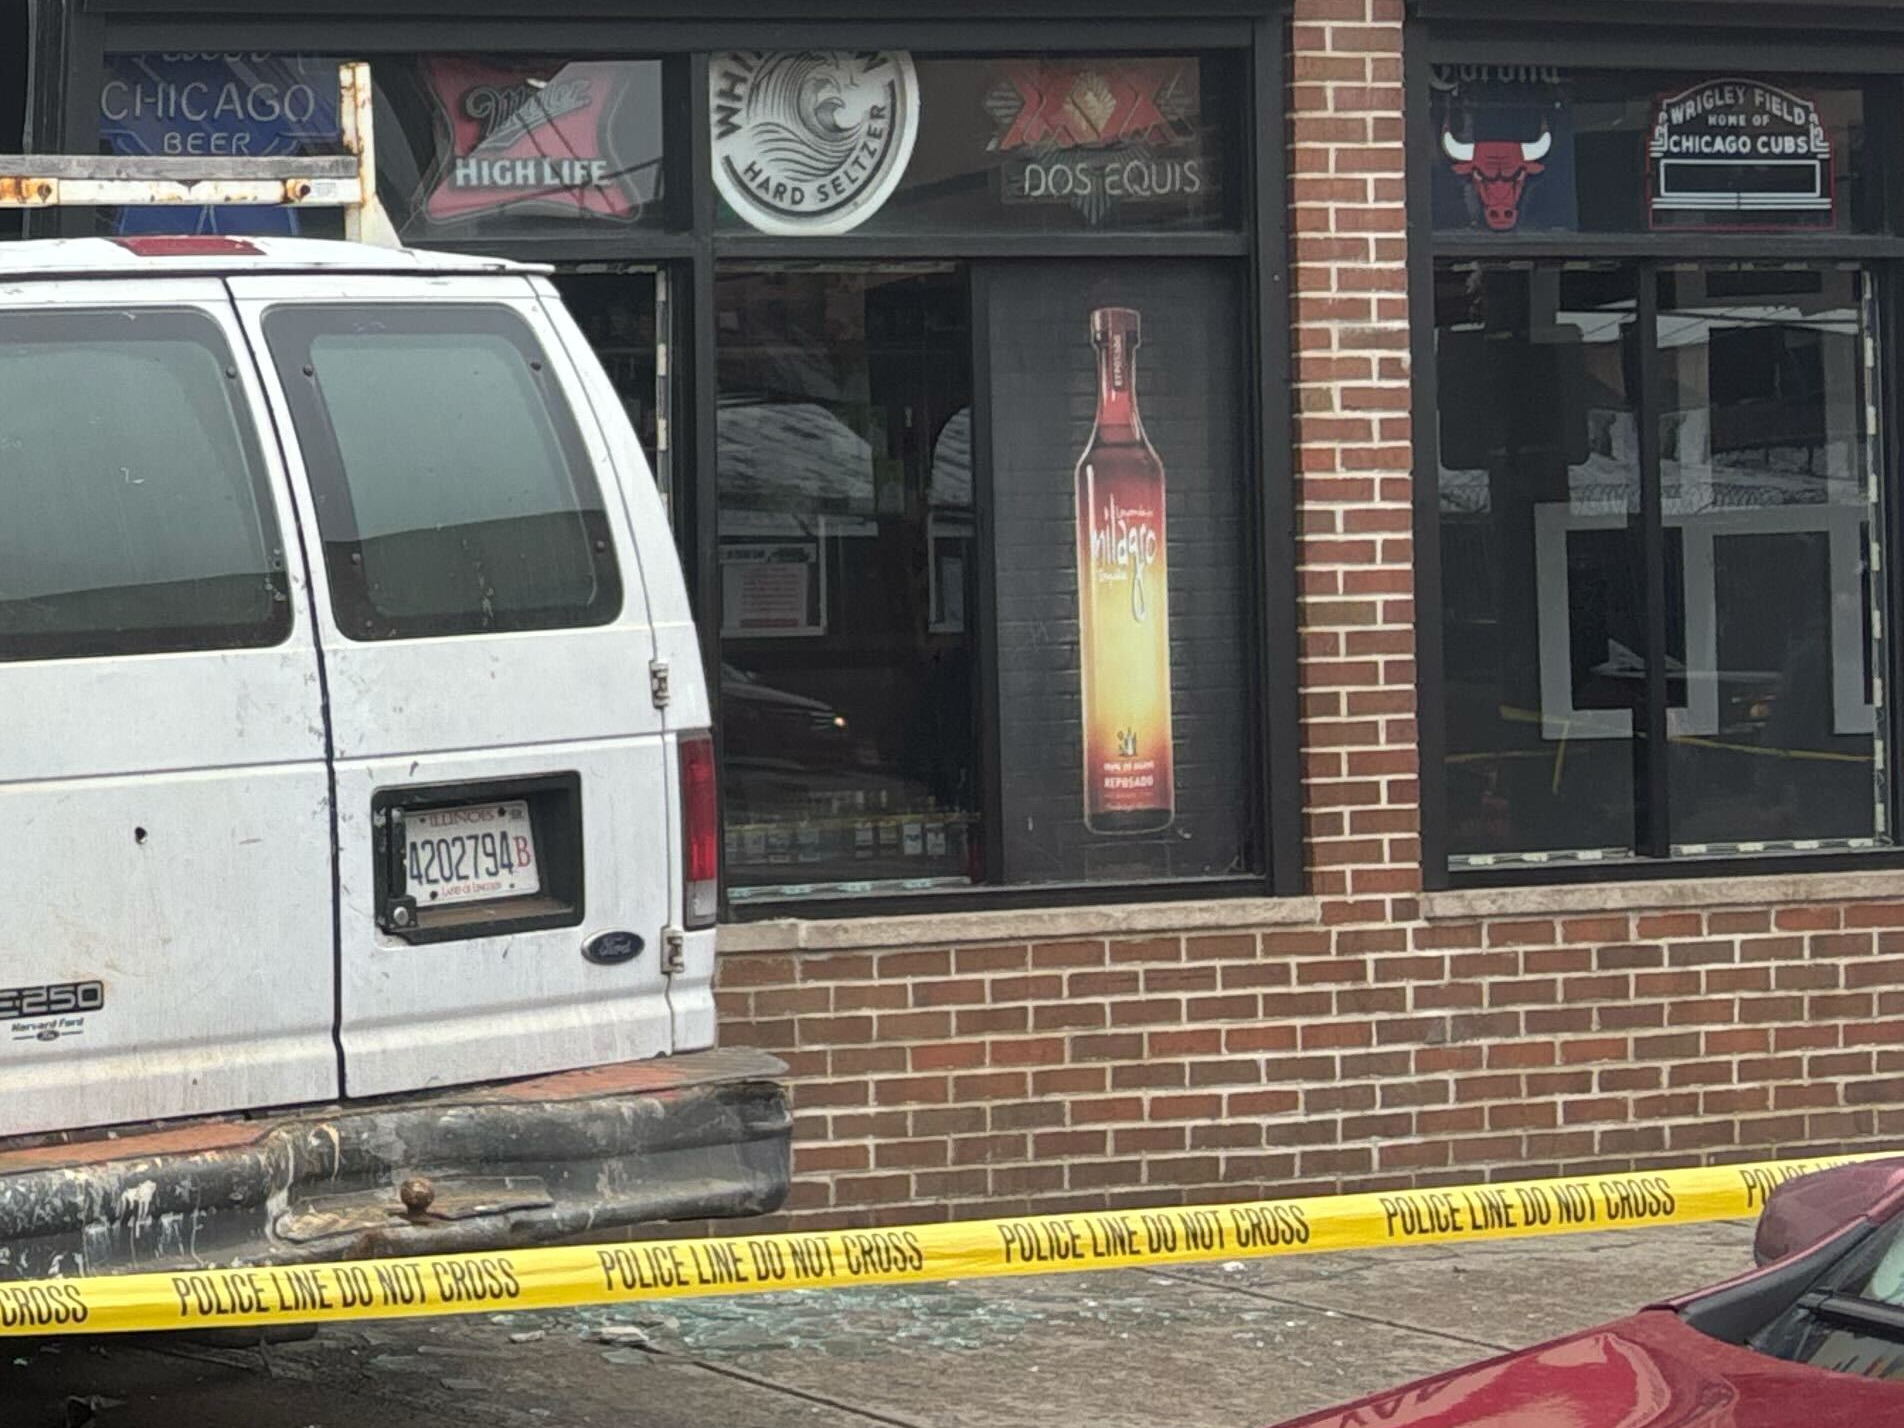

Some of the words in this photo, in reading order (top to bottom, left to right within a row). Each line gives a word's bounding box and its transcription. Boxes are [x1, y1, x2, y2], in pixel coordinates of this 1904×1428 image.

[101, 80, 315, 122] CHICAGO
[466, 78, 592, 140] Miller
[714, 50, 763, 141] WHI
[1669, 84, 1746, 127] WRIGLEY
[1753, 89, 1806, 126] FIELD
[1708, 113, 1746, 128] HOME
[1752, 112, 1770, 127] OF
[163, 131, 252, 156] BEER
[743, 160, 805, 205] HARD
[816, 104, 887, 203] SELTZER
[1669, 133, 1751, 155] CHICAGO
[1756, 133, 1809, 155] CUBS
[455, 157, 537, 187] HIGH
[543, 158, 612, 187] LIFE
[1024, 163, 1092, 197] DOS
[1103, 159, 1202, 197] EQUIS
[428, 810, 496, 826] ILLINOIS
[1380, 1194, 1465, 1237] POLICE
[1468, 1192, 1515, 1231] LINE
[1516, 1191, 1551, 1228] DO
[1552, 1186, 1599, 1224] NOT
[1598, 1180, 1677, 1222] CROSS
[997, 1220, 1084, 1265] POLICE
[1089, 1218, 1139, 1259] LINE
[1141, 1219, 1178, 1255] DO
[1181, 1215, 1226, 1252] NOT
[1227, 1210, 1312, 1249] CROSS
[600, 1245, 691, 1291] POLICE
[695, 1242, 749, 1285] LINE
[753, 1240, 787, 1283] DO
[791, 1237, 837, 1280] NOT
[840, 1232, 925, 1277] CROSS
[171, 1274, 270, 1318] POLICE
[275, 1269, 333, 1313] LINE
[337, 1268, 375, 1310] DO
[380, 1264, 428, 1308] NOT
[434, 1261, 520, 1303] CROSS
